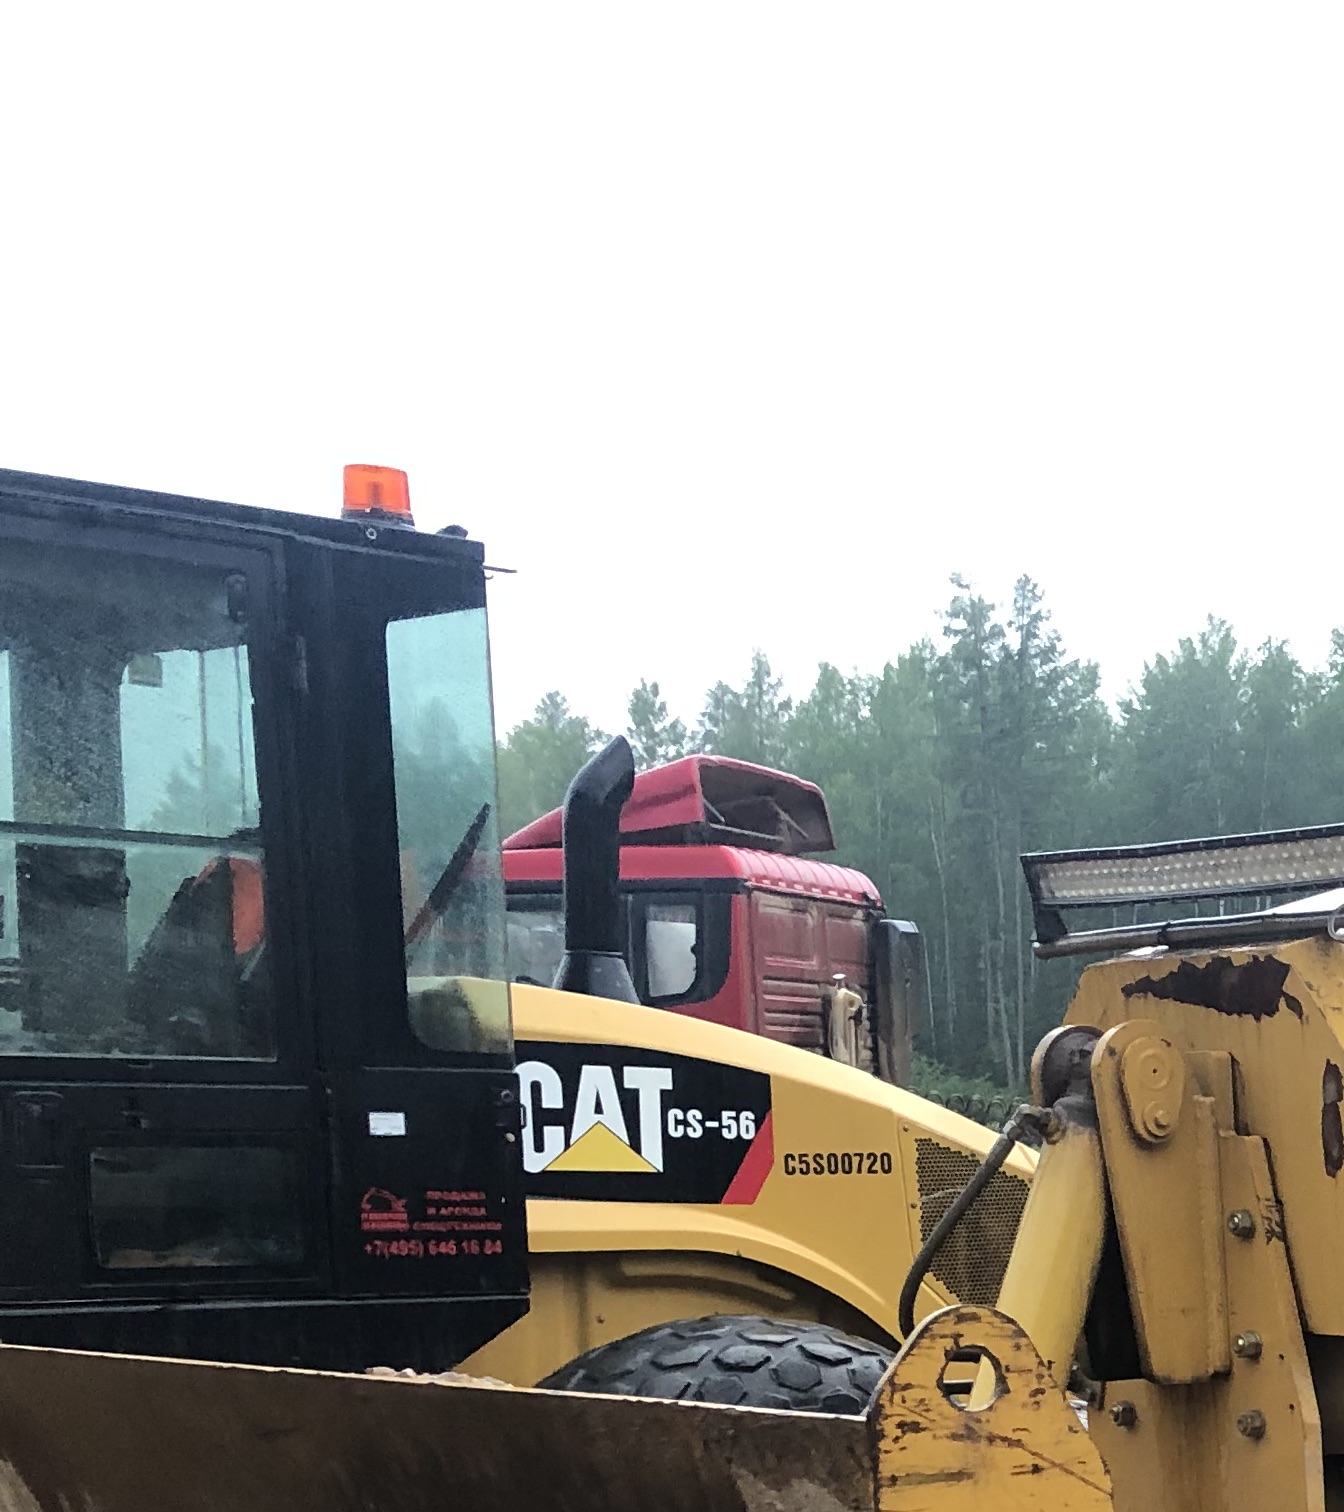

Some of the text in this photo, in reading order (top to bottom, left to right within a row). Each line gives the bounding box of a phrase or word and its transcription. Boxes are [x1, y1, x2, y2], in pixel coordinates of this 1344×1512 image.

[513, 1061, 673, 1174] CAT
[666, 1107, 756, 1141] CS-56
[783, 1152, 893, 1176] C5S00720
